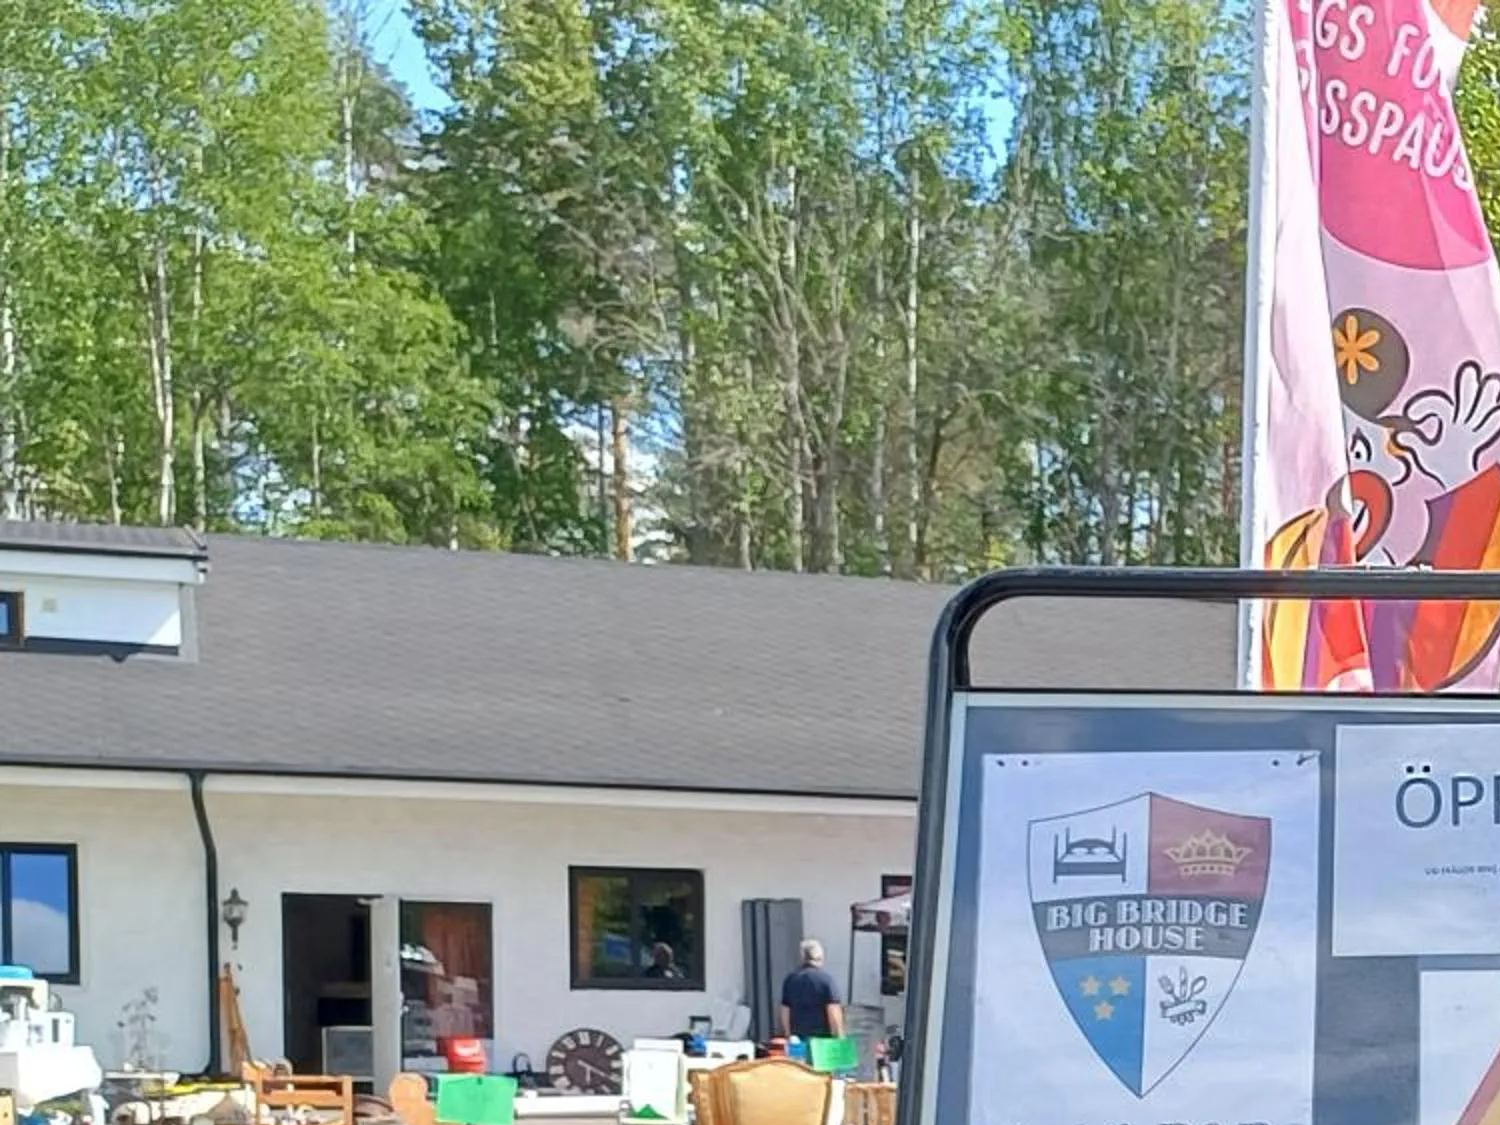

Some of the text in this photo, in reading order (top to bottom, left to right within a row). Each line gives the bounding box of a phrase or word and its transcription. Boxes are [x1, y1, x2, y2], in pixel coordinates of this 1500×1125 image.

[1315, 0, 1375, 60] GS
[1046, 899, 1248, 931] BIG BRIDGE
[1088, 925, 1205, 951] HOUSE
